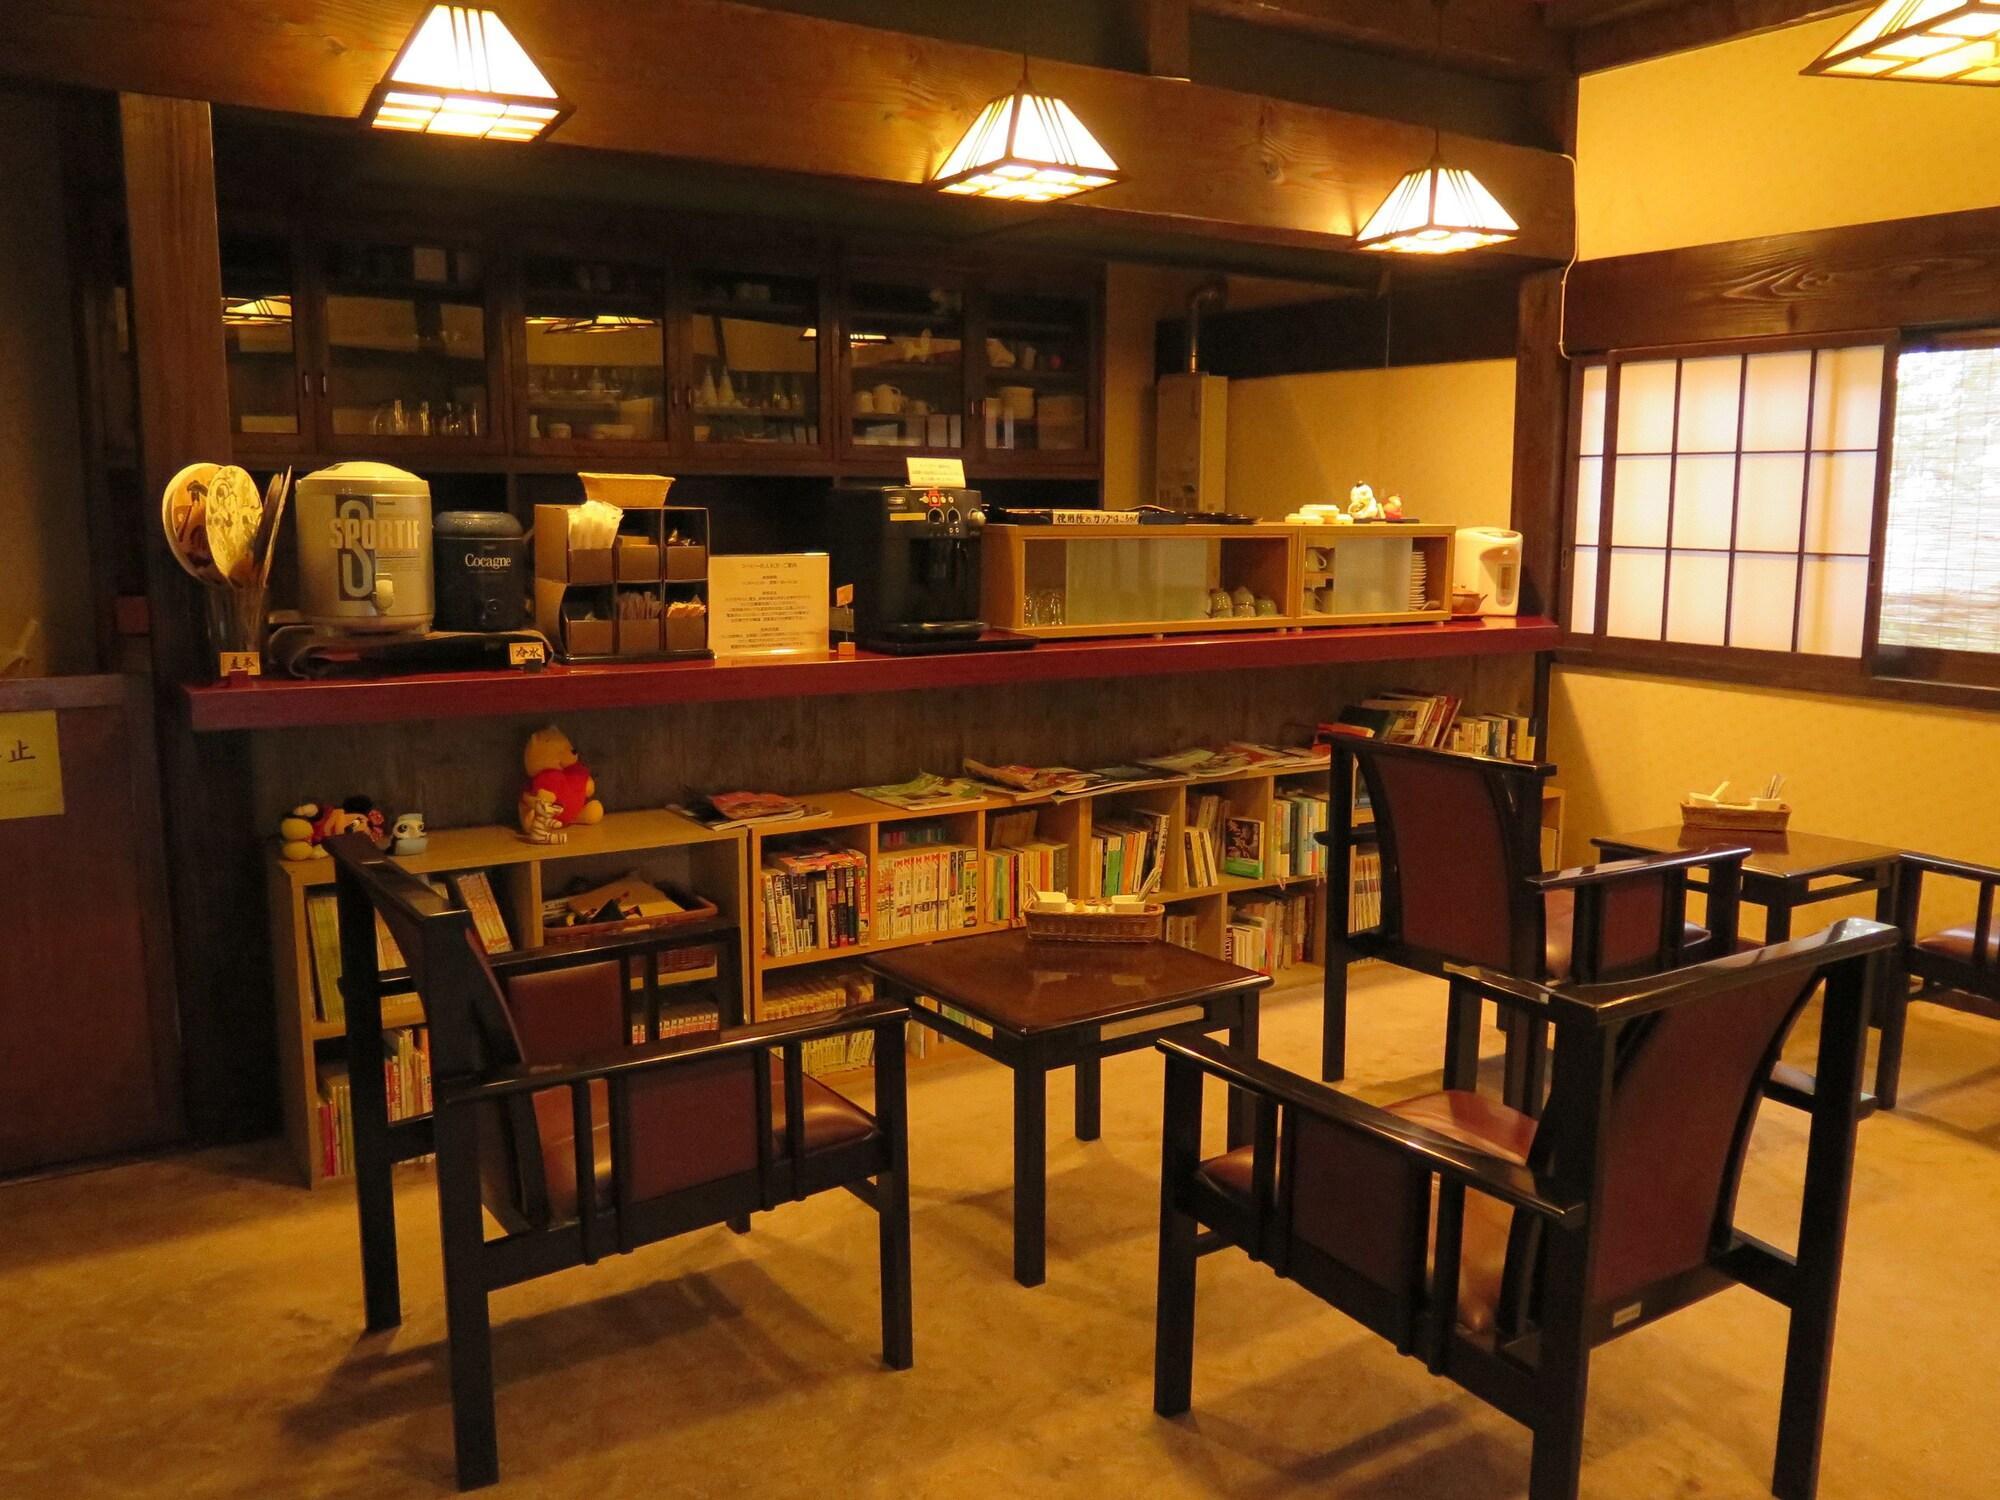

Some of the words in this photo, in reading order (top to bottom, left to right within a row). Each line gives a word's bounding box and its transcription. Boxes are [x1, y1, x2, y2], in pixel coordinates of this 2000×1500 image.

[329, 518, 420, 550] SPORTIF
[465, 553, 511, 570] Cocagne
[516, 646, 542, 658] 冷水
[0, 739, 36, 763] 止
